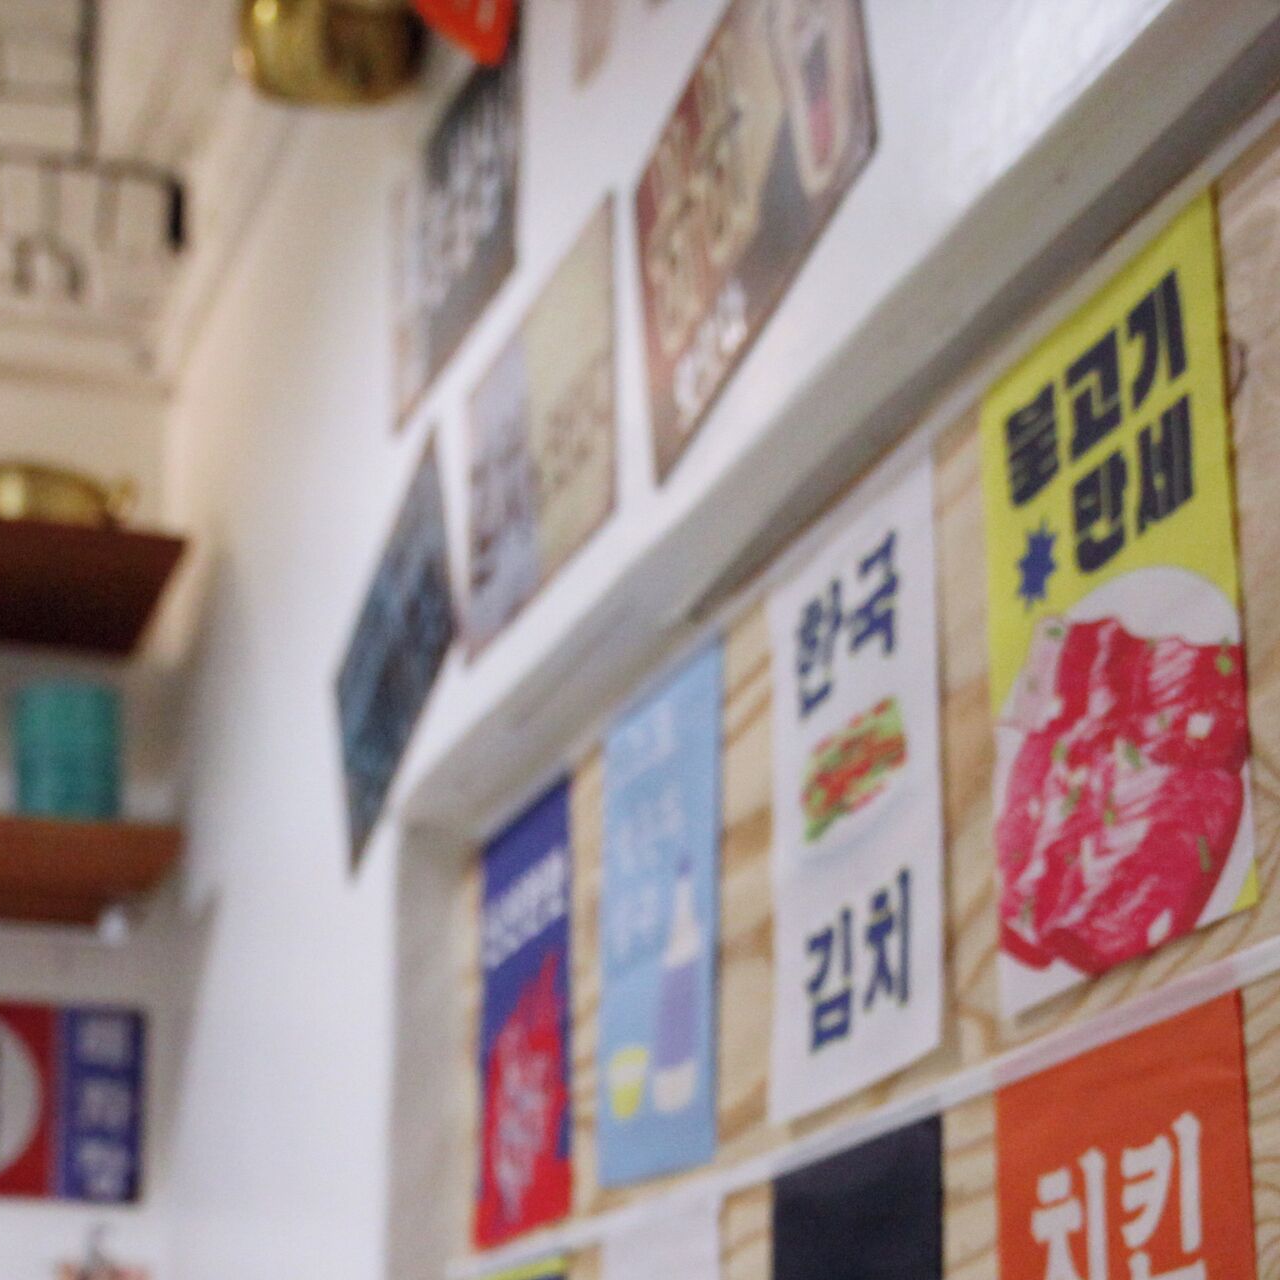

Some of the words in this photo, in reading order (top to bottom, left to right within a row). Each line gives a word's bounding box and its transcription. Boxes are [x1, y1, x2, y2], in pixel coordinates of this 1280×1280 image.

[1006, 267, 1187, 507] 불고기
[1073, 393, 1194, 575] 만세
[796, 527, 898, 719] 한국
[807, 868, 910, 1054] 김치
